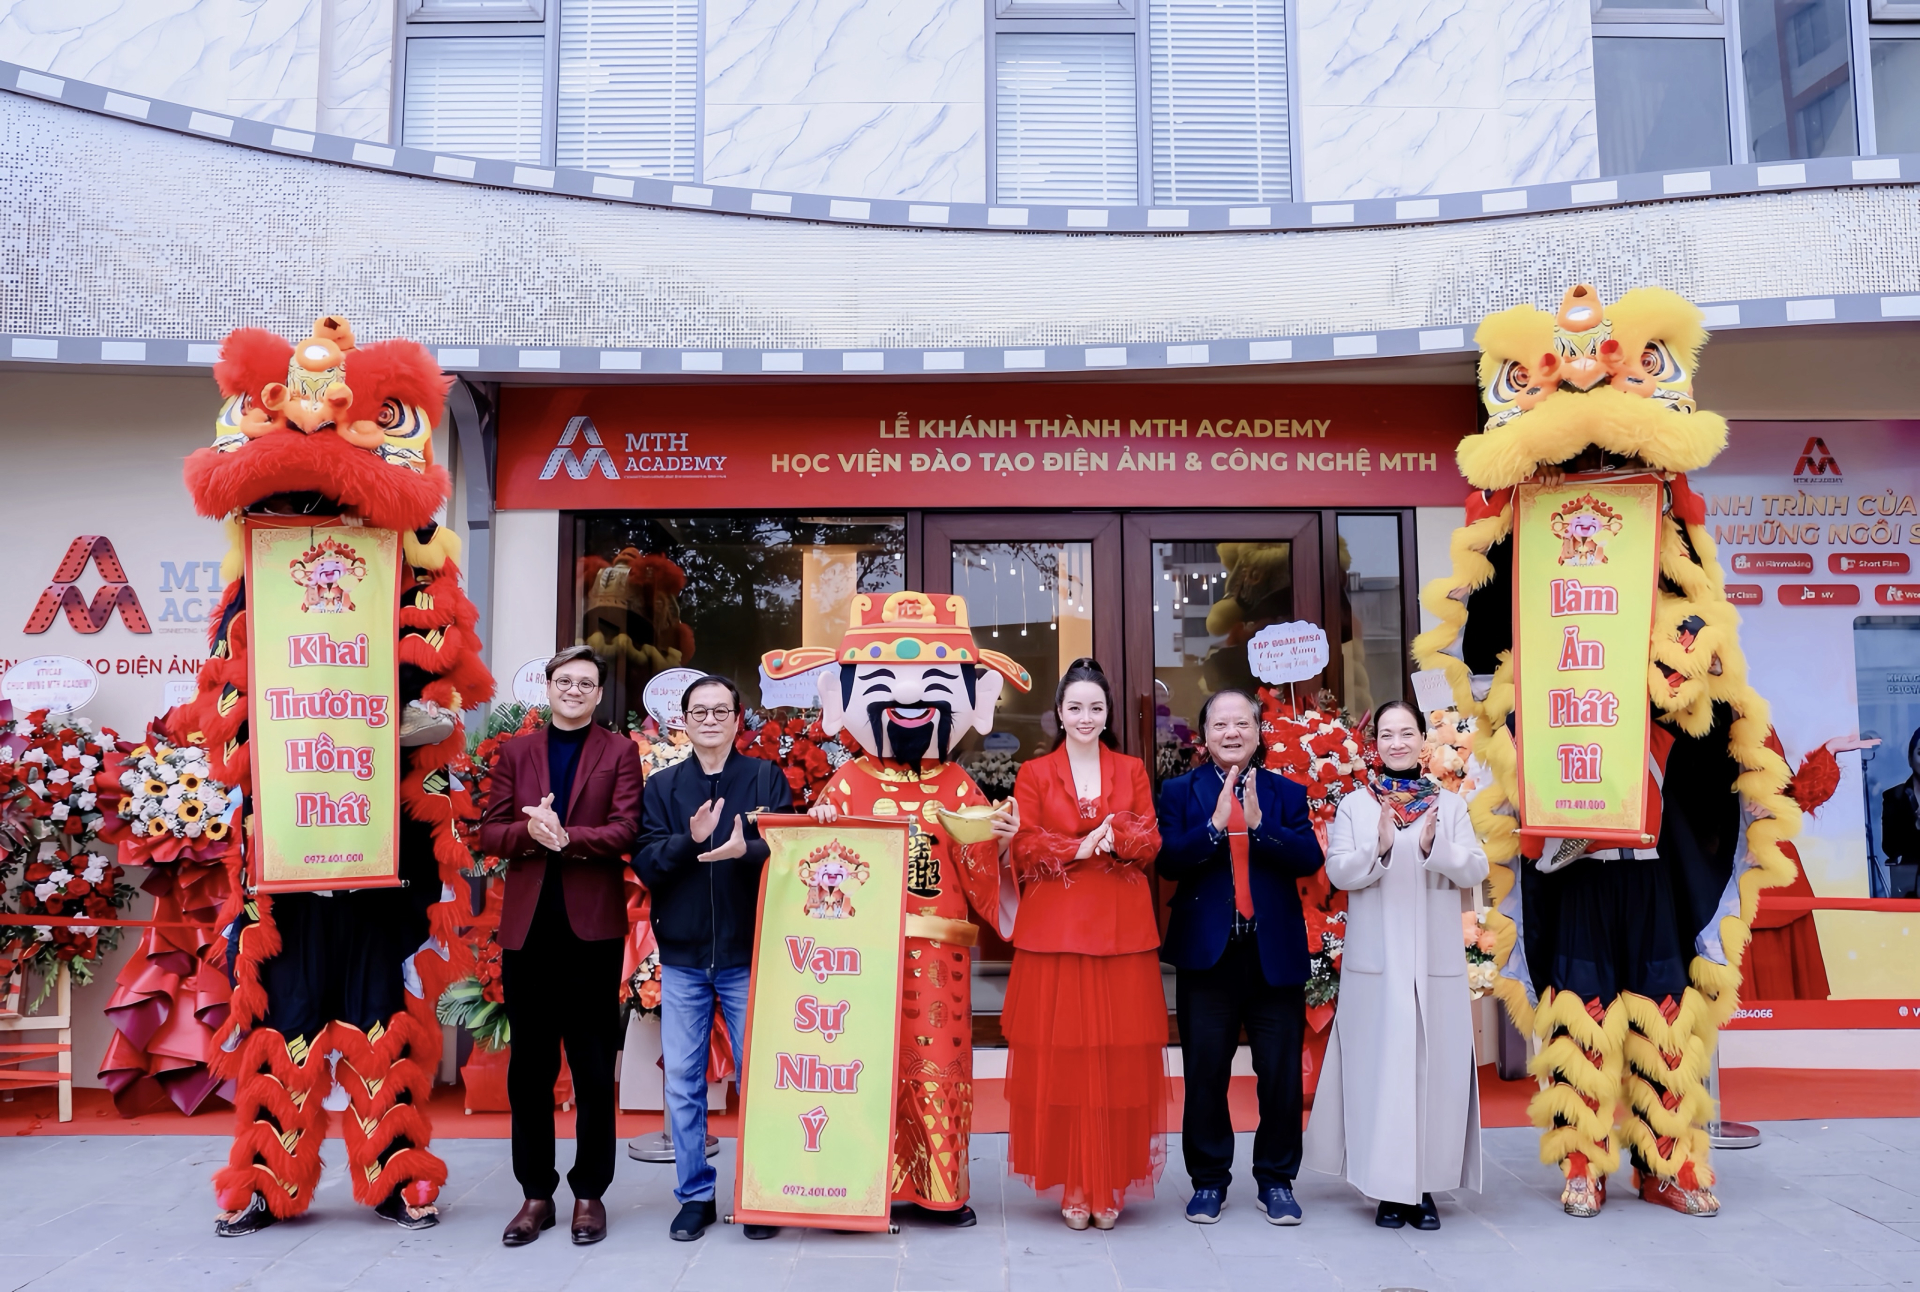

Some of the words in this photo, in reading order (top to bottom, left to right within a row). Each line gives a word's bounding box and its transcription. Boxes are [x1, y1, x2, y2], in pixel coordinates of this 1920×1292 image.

[625, 433, 689, 452] MTH
[879, 411, 911, 438] LỄ
[919, 414, 1017, 438] KHÁNH
[1024, 414, 1121, 438] THÀNH
[1129, 419, 1188, 438] MTH
[1196, 419, 1331, 438] ACADEMY
[624, 456, 728, 472] ACADEMY
[771, 453, 830, 478] HỌC
[837, 448, 902, 478] VIỆN
[909, 448, 972, 472] ĐÀO
[979, 452, 1035, 477] TẠO
[1042, 447, 1109, 477] ĐIỆN
[1116, 446, 1176, 471] ẢNH
[1184, 452, 1203, 471] &
[1210, 447, 1288, 471] CÔNG
[1297, 447, 1371, 477] NGHỆ
[1379, 453, 1437, 471] MTH
[1761, 489, 1850, 516] TRÌNH
[1857, 488, 1918, 516] CỦA
[1715, 519, 1821, 545] NHỮNG
[1828, 519, 1901, 545] NGÔI
[159, 561, 223, 592] MT
[1550, 579, 1619, 617] Làm
[116, 655, 163, 678] ĐIỆN
[288, 632, 370, 668] Khai
[1557, 626, 1605, 672] Ăn
[535, 672, 547, 685] RO
[264, 687, 390, 728] Trương
[1549, 688, 1619, 728] Phát
[286, 732, 375, 781] Hồng
[1557, 743, 1603, 784] Tài
[296, 791, 371, 827] Phát
[785, 935, 861, 983] Vạn
[793, 994, 850, 1042] Sự
[774, 1052, 864, 1094] Như
[798, 1106, 829, 1152] Ý
